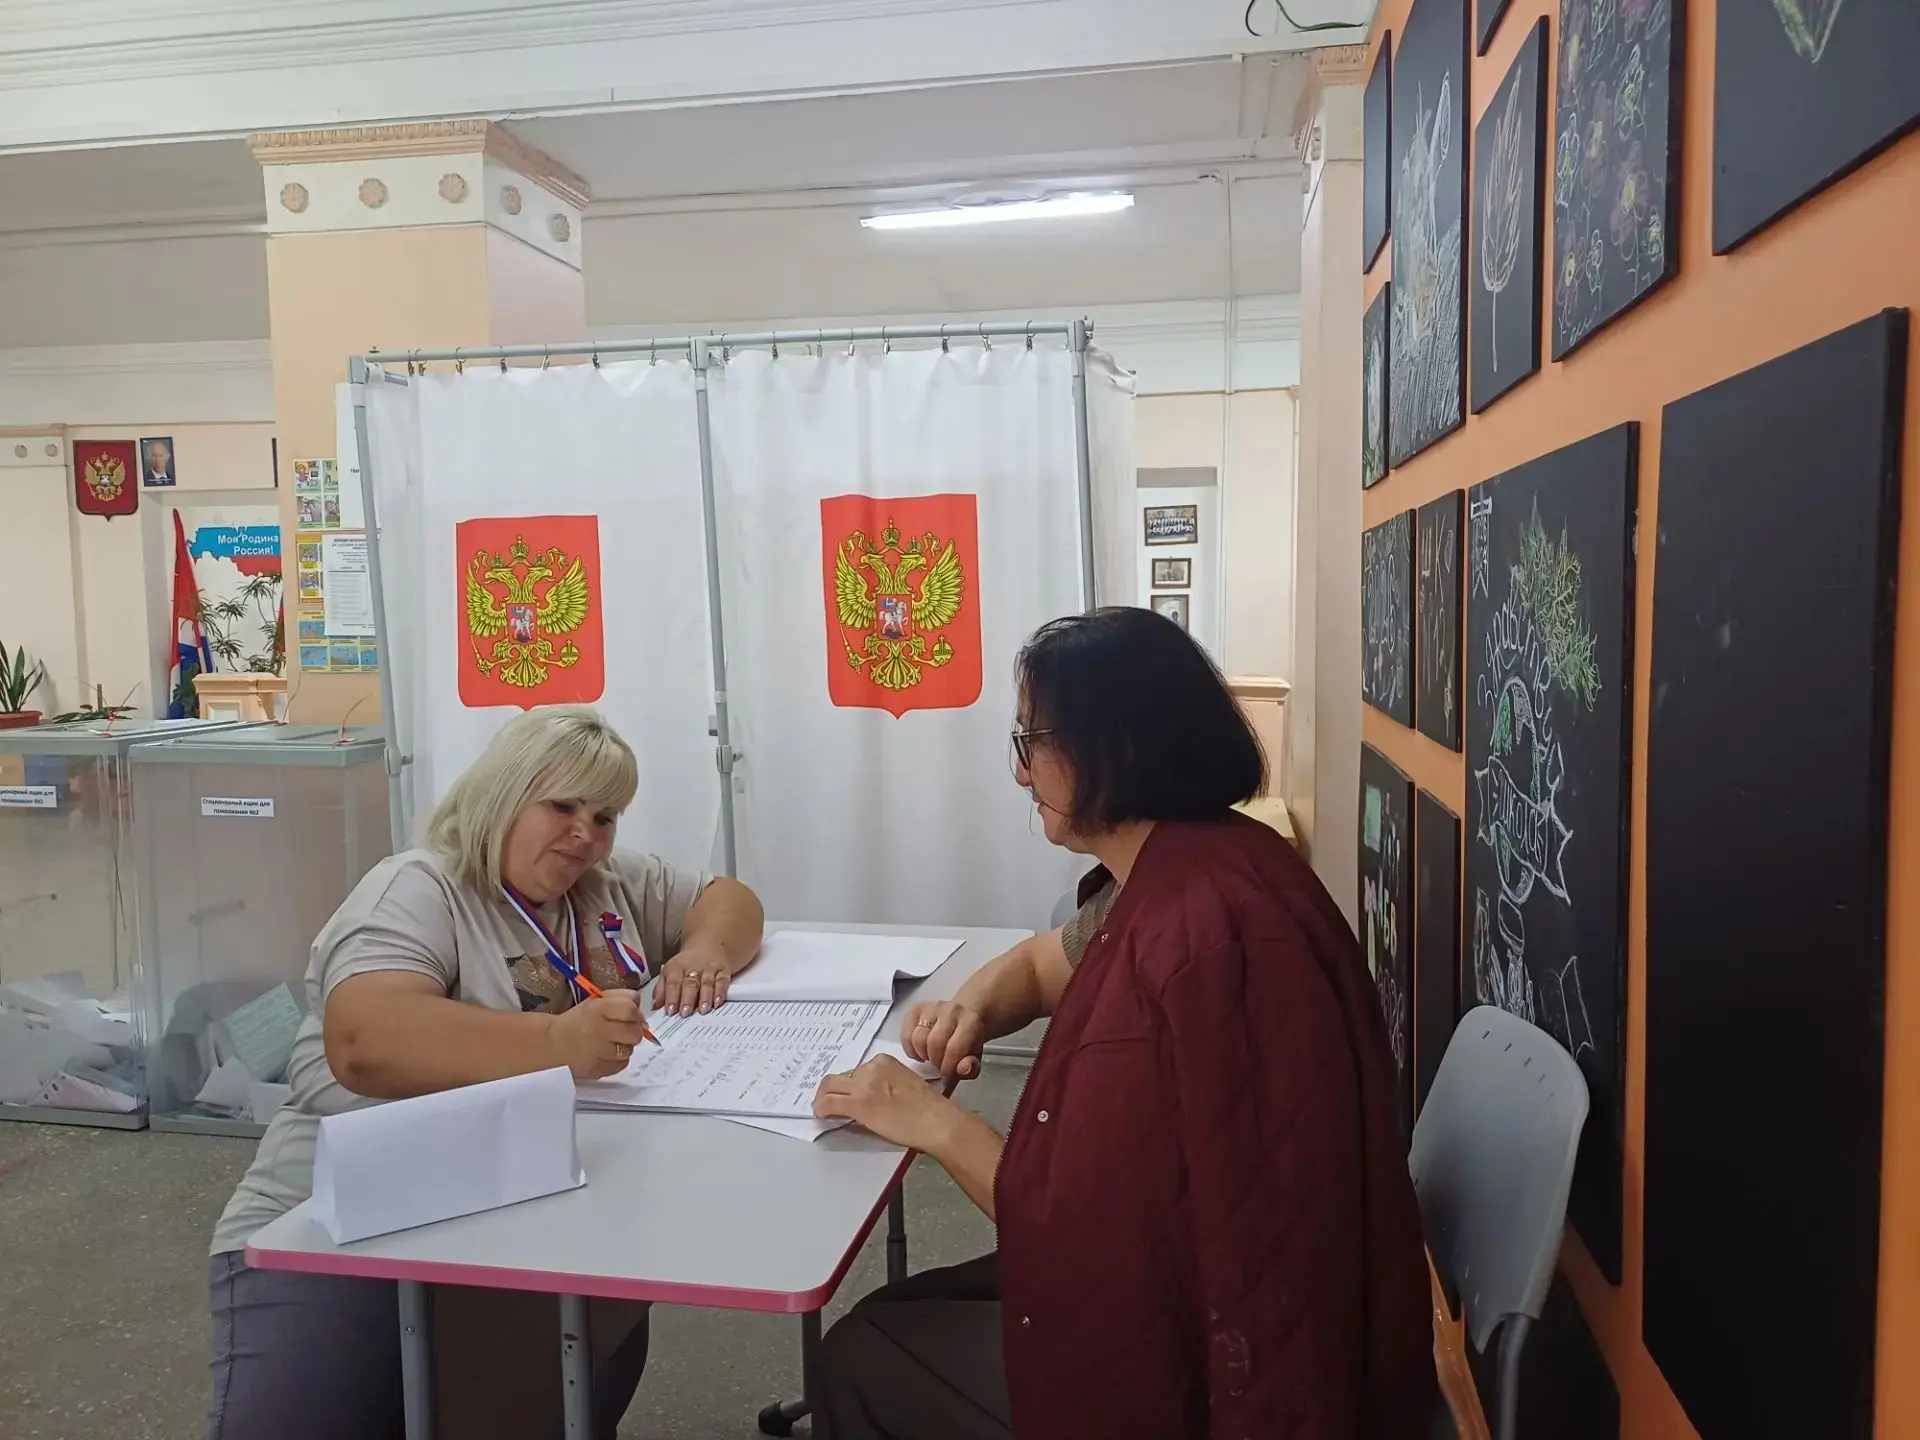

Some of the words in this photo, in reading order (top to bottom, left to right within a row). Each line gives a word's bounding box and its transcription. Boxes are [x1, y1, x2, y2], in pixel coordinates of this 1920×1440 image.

[217, 534, 239, 545] Моя
[241, 534, 279, 546] Родина
[233, 545, 273, 556] Россия!
